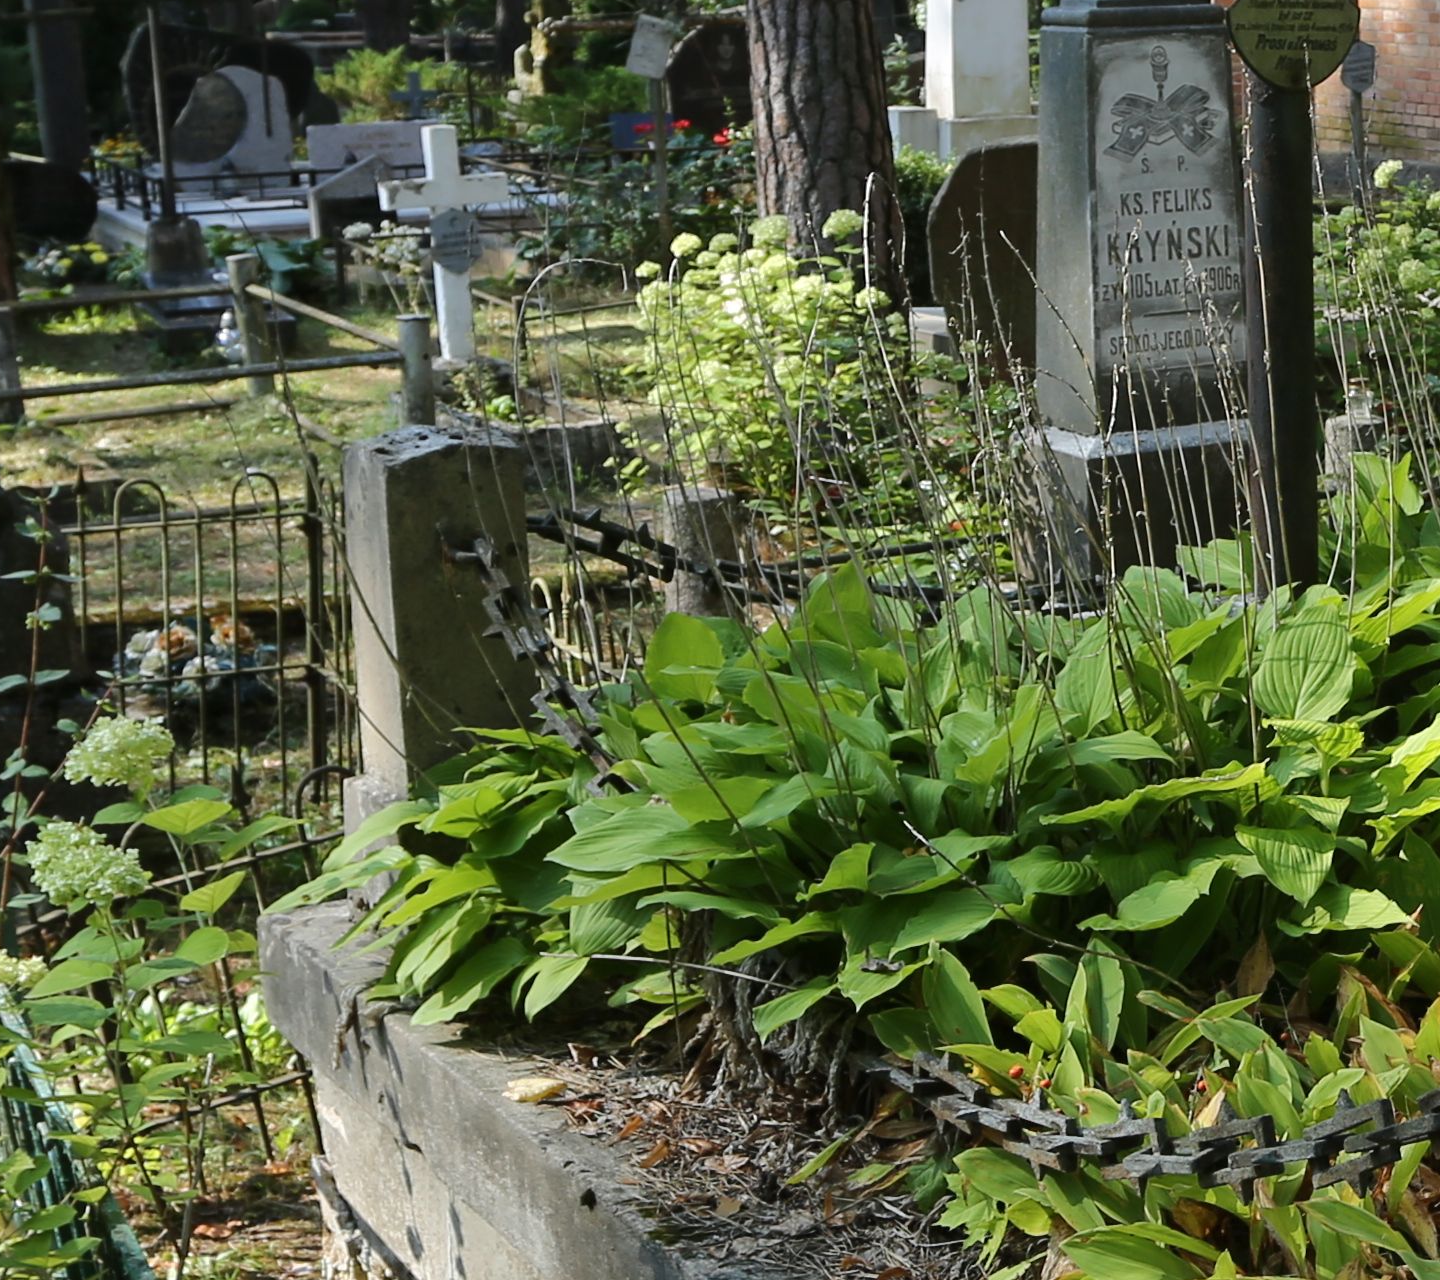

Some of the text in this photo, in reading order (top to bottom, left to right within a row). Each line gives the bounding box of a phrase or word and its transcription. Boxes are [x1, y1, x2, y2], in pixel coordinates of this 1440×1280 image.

[1177, 155, 1188, 171] P.
[1120, 188, 1212, 216] KS. FELIKS
[1107, 220, 1230, 266] KRYŃSKI
[1130, 273, 1152, 300] 105
[1161, 329, 1193, 351] JEGO
